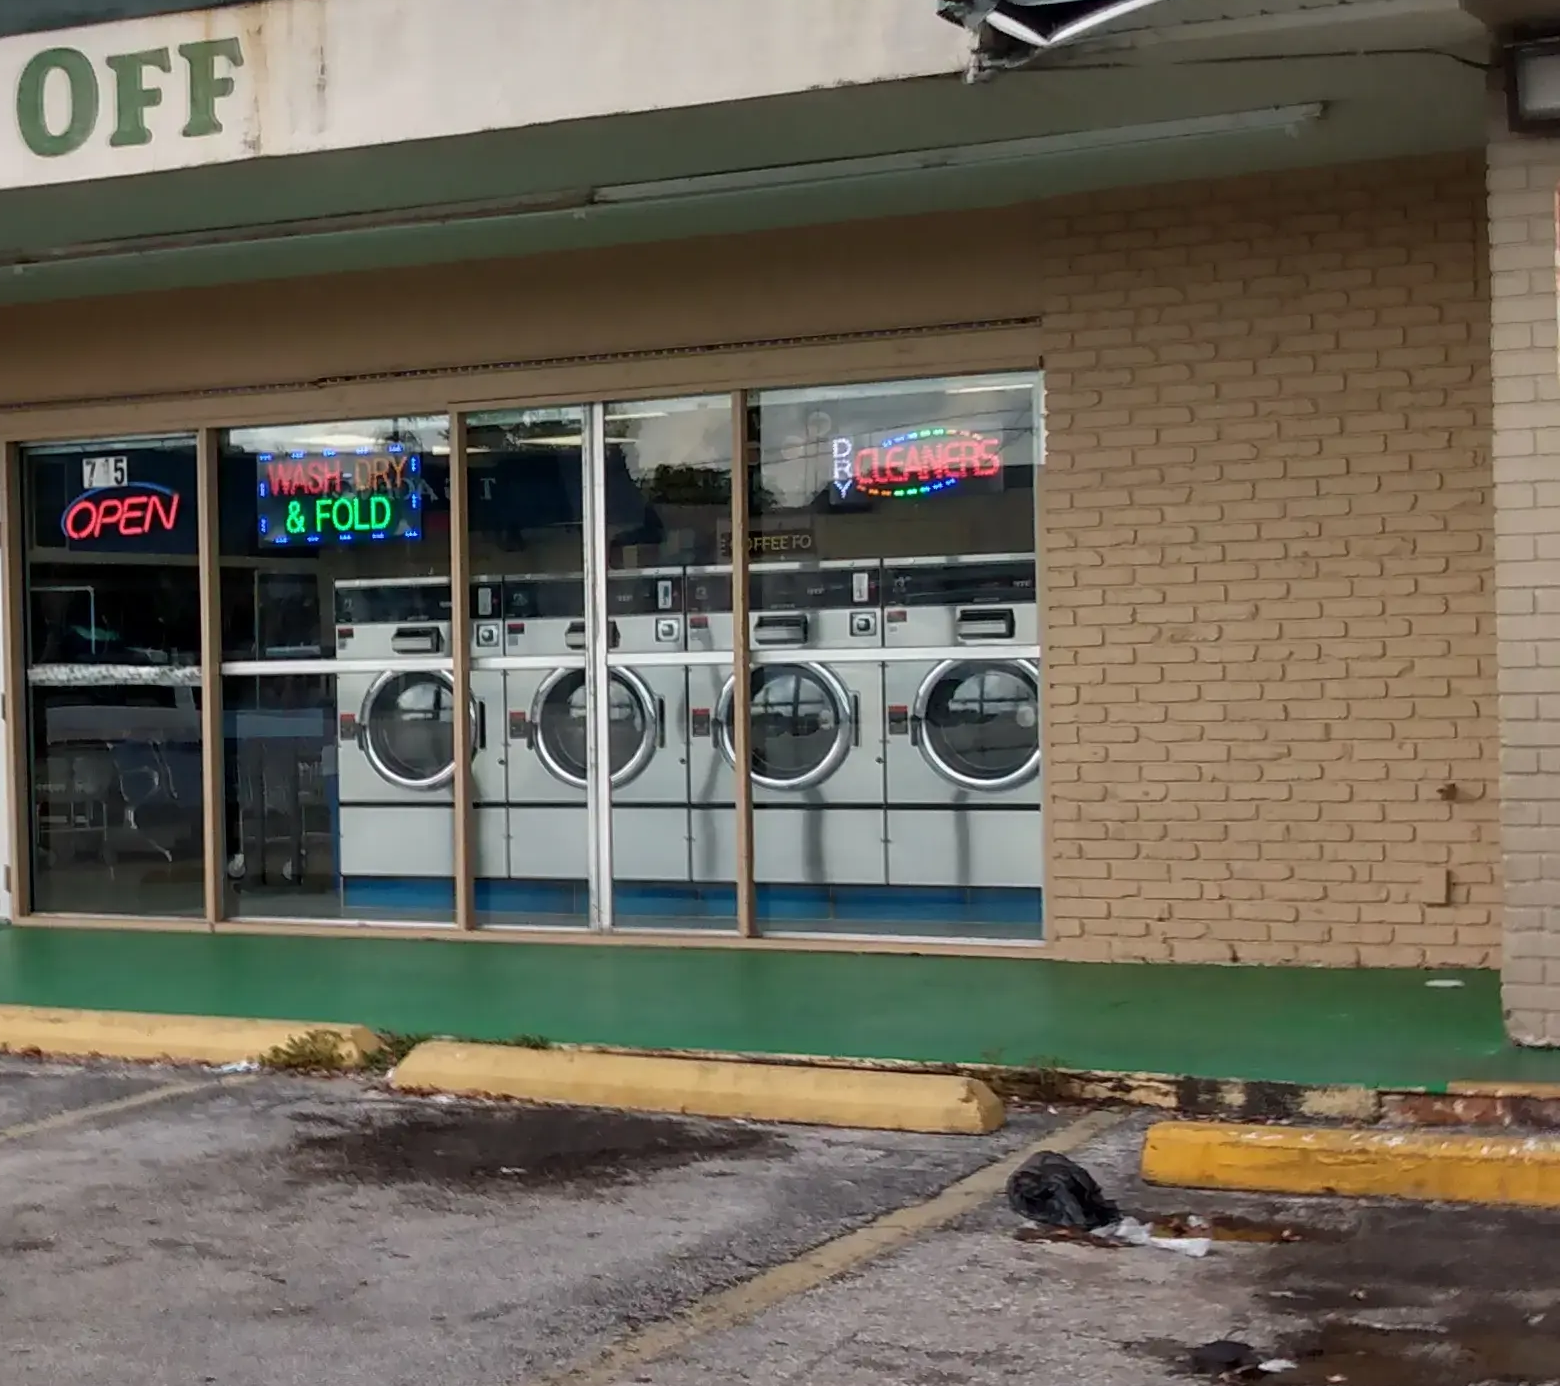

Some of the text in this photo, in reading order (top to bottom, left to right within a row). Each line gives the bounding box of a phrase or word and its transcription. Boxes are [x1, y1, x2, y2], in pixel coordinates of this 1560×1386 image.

[16, 36, 244, 158] OFF
[832, 438, 853, 499] DRY
[854, 439, 1001, 485] CLEANERS
[66, 493, 180, 540] OPEN
[286, 496, 392, 534] & FOLD
